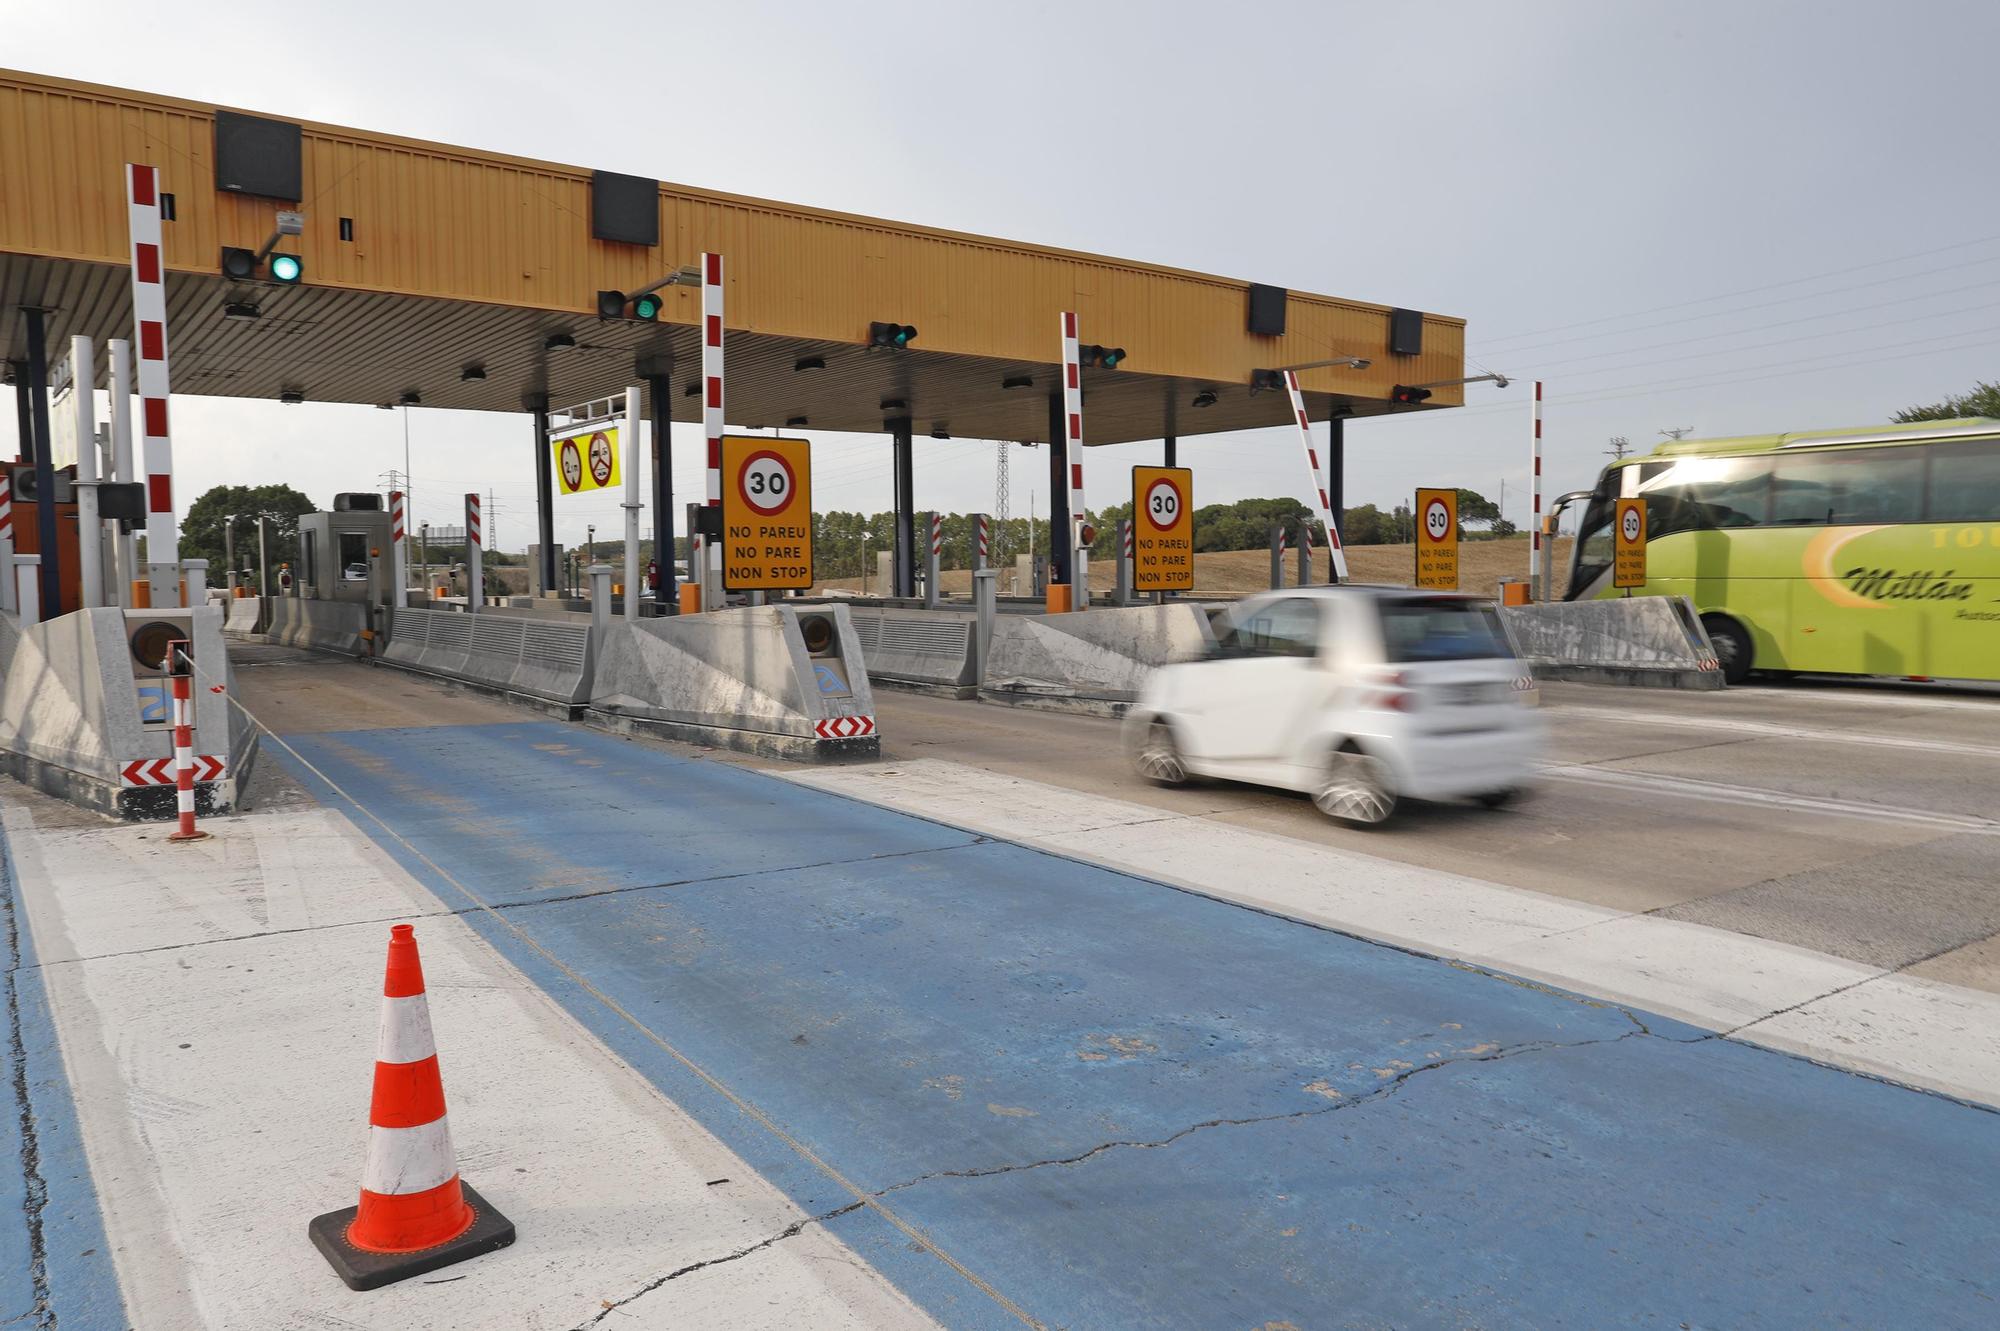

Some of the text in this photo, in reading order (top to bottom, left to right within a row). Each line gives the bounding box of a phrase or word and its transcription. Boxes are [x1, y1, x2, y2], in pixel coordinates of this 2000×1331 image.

[750, 472, 785, 495] 30
[1153, 495, 1176, 514] 30
[1429, 512, 1446, 528] 30
[1625, 518, 1638, 532] 30
[729, 526, 806, 538] NO PAREU
[1139, 540, 1189, 549] NO PAREU
[735, 547, 801, 559] NO PARE
[1420, 549, 1430, 558] NO
[1143, 556, 1186, 566] NO PARE
[1423, 563, 1433, 571] NO
[729, 567, 807, 579] NON STOP
[1139, 572, 1190, 582] NON STOP
[1438, 576, 1455, 585] STOP
